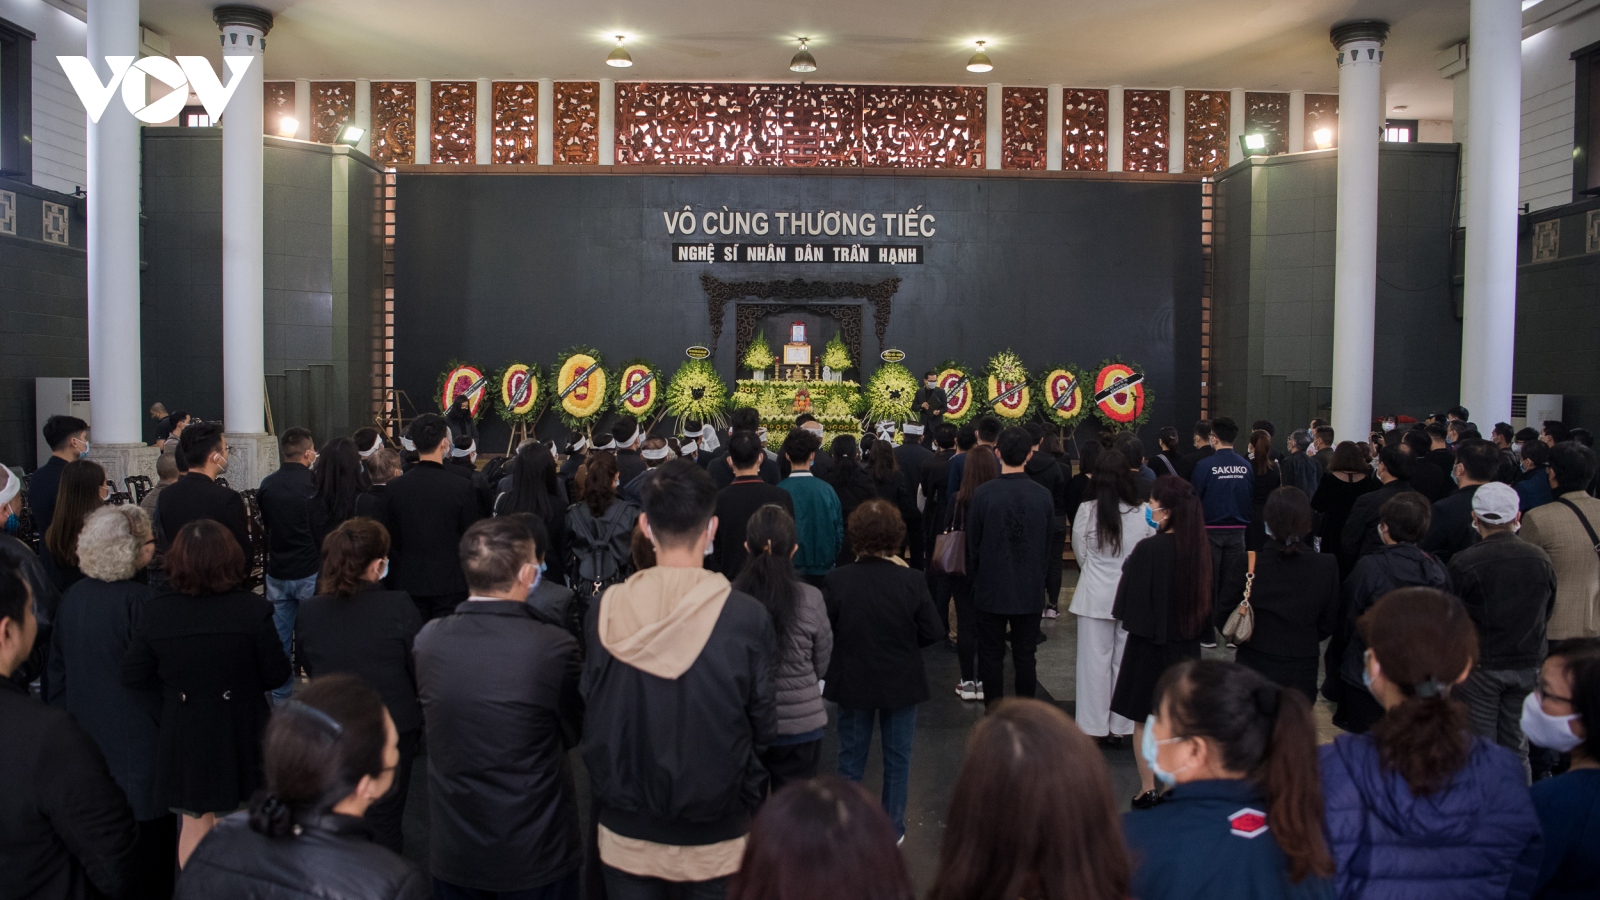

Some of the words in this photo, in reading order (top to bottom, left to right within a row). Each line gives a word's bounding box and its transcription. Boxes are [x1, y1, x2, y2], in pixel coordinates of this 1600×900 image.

[663, 205, 696, 234] VÔ
[702, 205, 769, 236] CÙNG
[774, 210, 876, 237] THƯƠNG
[882, 205, 936, 237] TIẾC
[678, 242, 715, 264] NGHỆ
[723, 243, 739, 262] SĨ
[747, 243, 786, 262] NHÂN
[795, 243, 824, 262] DÂN
[833, 243, 869, 262] TRẦN
[878, 248, 917, 265] HẠNH
[1211, 466, 1248, 474] SAKUKO
